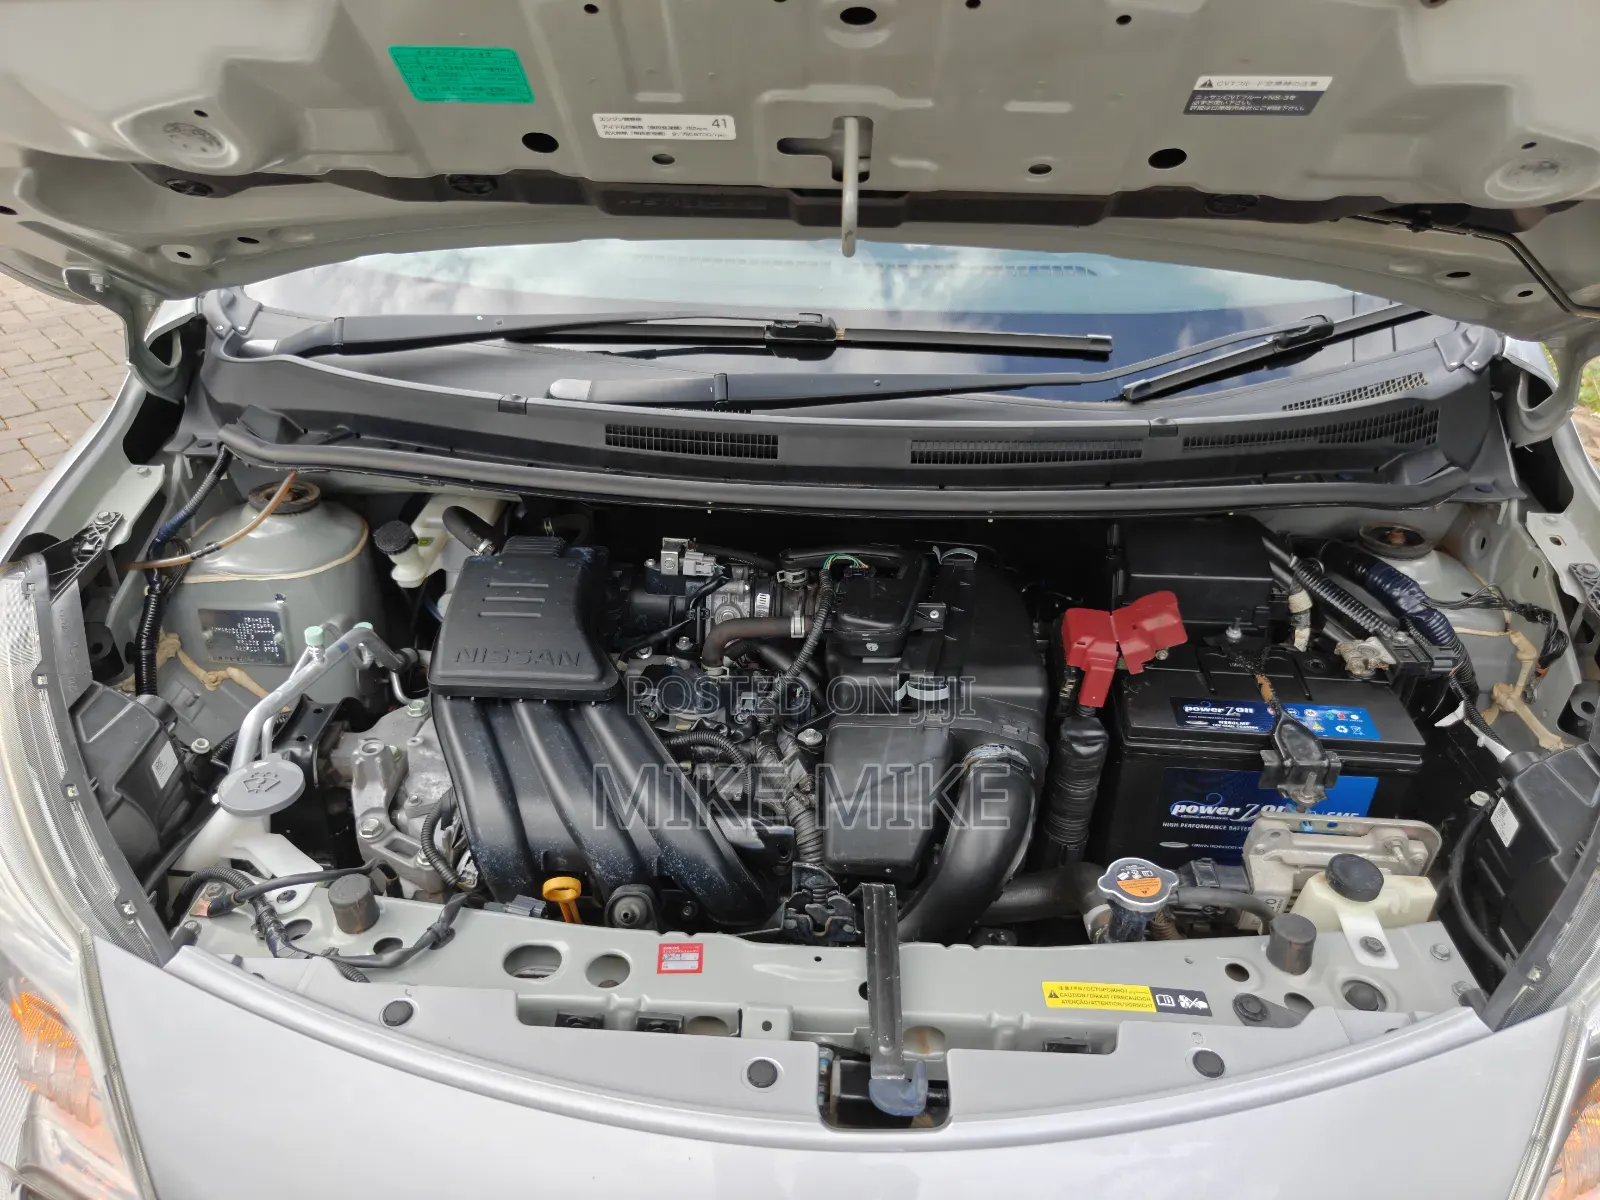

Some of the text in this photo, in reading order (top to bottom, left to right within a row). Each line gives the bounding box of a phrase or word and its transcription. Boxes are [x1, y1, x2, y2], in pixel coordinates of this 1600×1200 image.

[711, 118, 728, 129] 41
[453, 647, 582, 667] NISSAN
[1180, 822, 1228, 831] PERFORMANCE
